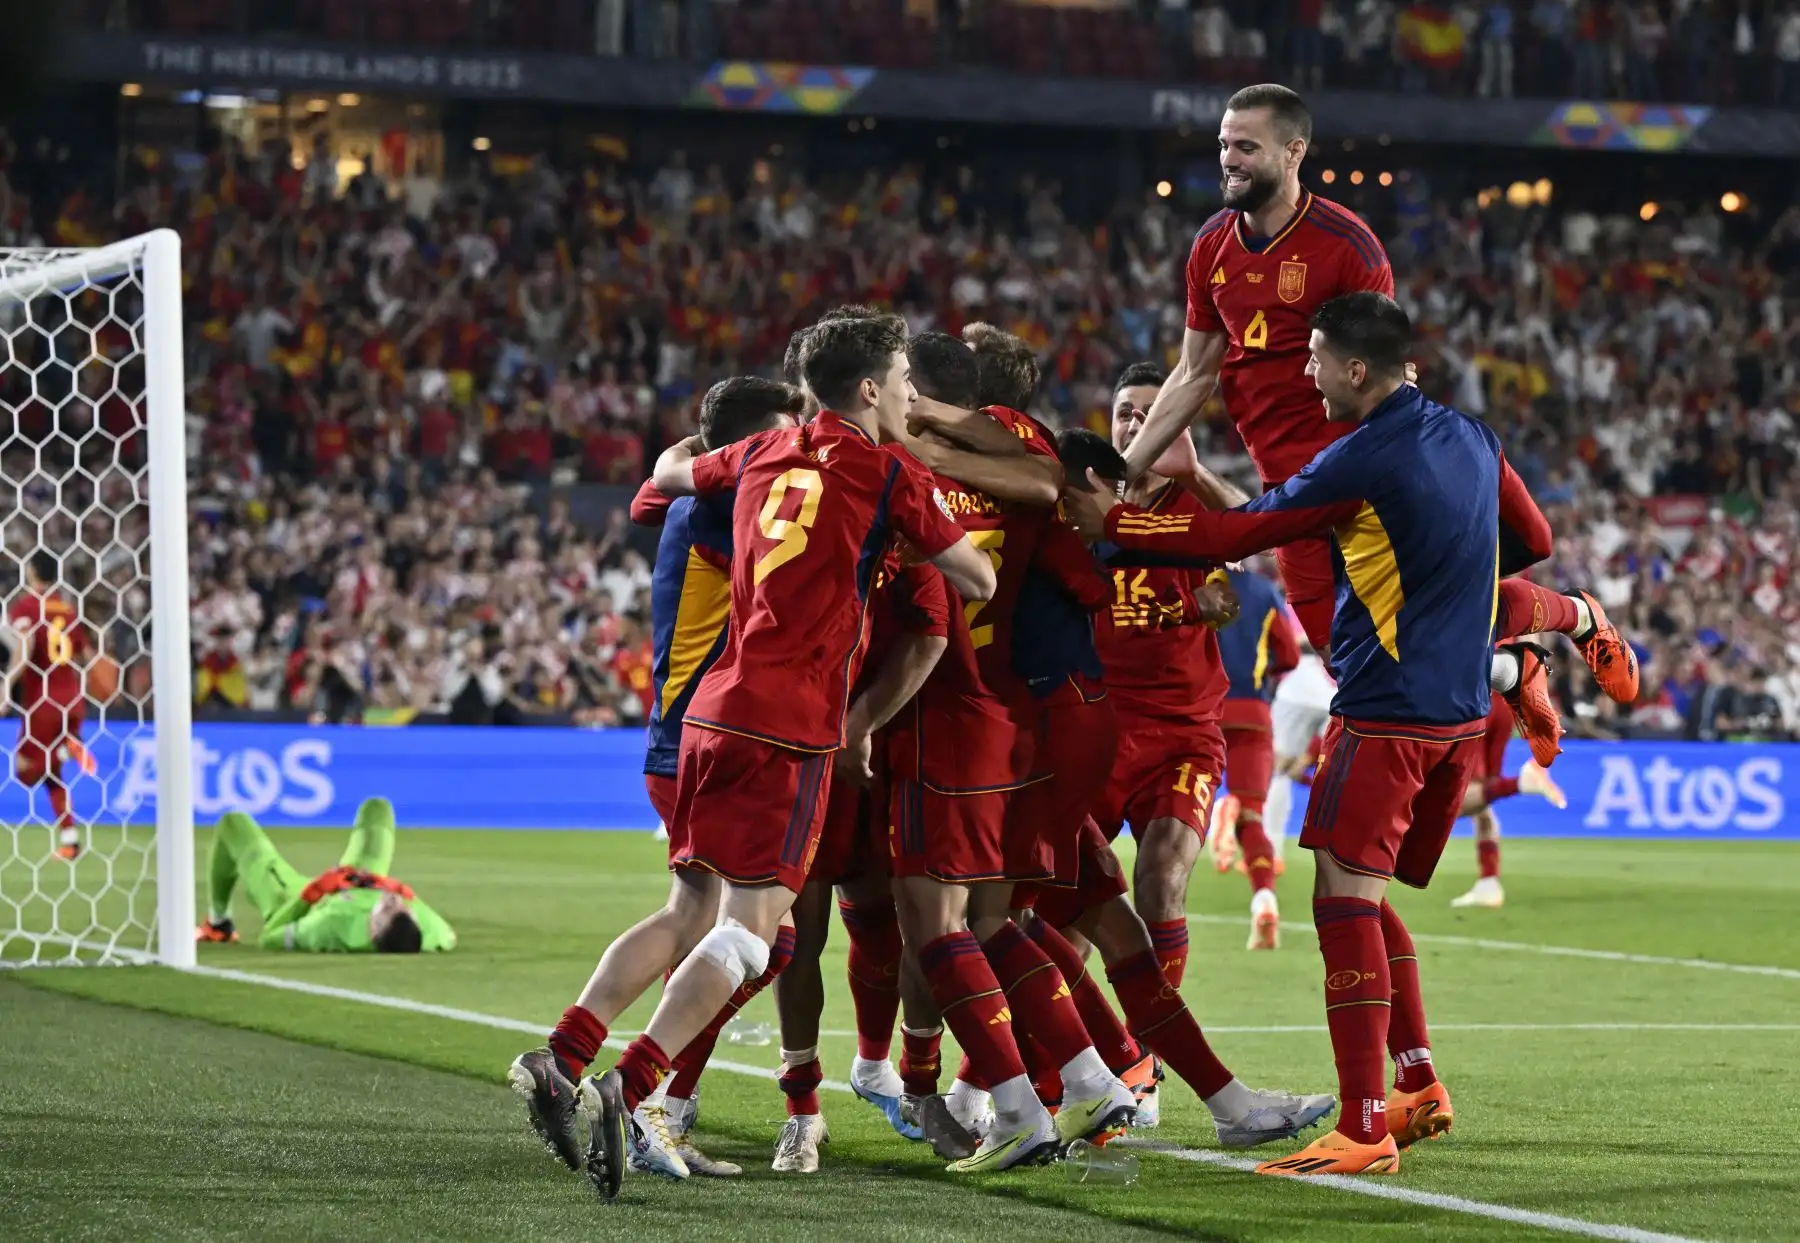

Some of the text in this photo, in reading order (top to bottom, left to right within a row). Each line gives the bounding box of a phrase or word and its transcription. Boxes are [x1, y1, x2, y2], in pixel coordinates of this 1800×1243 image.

[1244, 310, 1268, 351] 4
[754, 467, 824, 587] 9
[1113, 568, 1156, 604] 16
[47, 614, 73, 667] 6
[1172, 762, 1212, 811] 16
[1362, 1098, 1372, 1133] DESIGN
